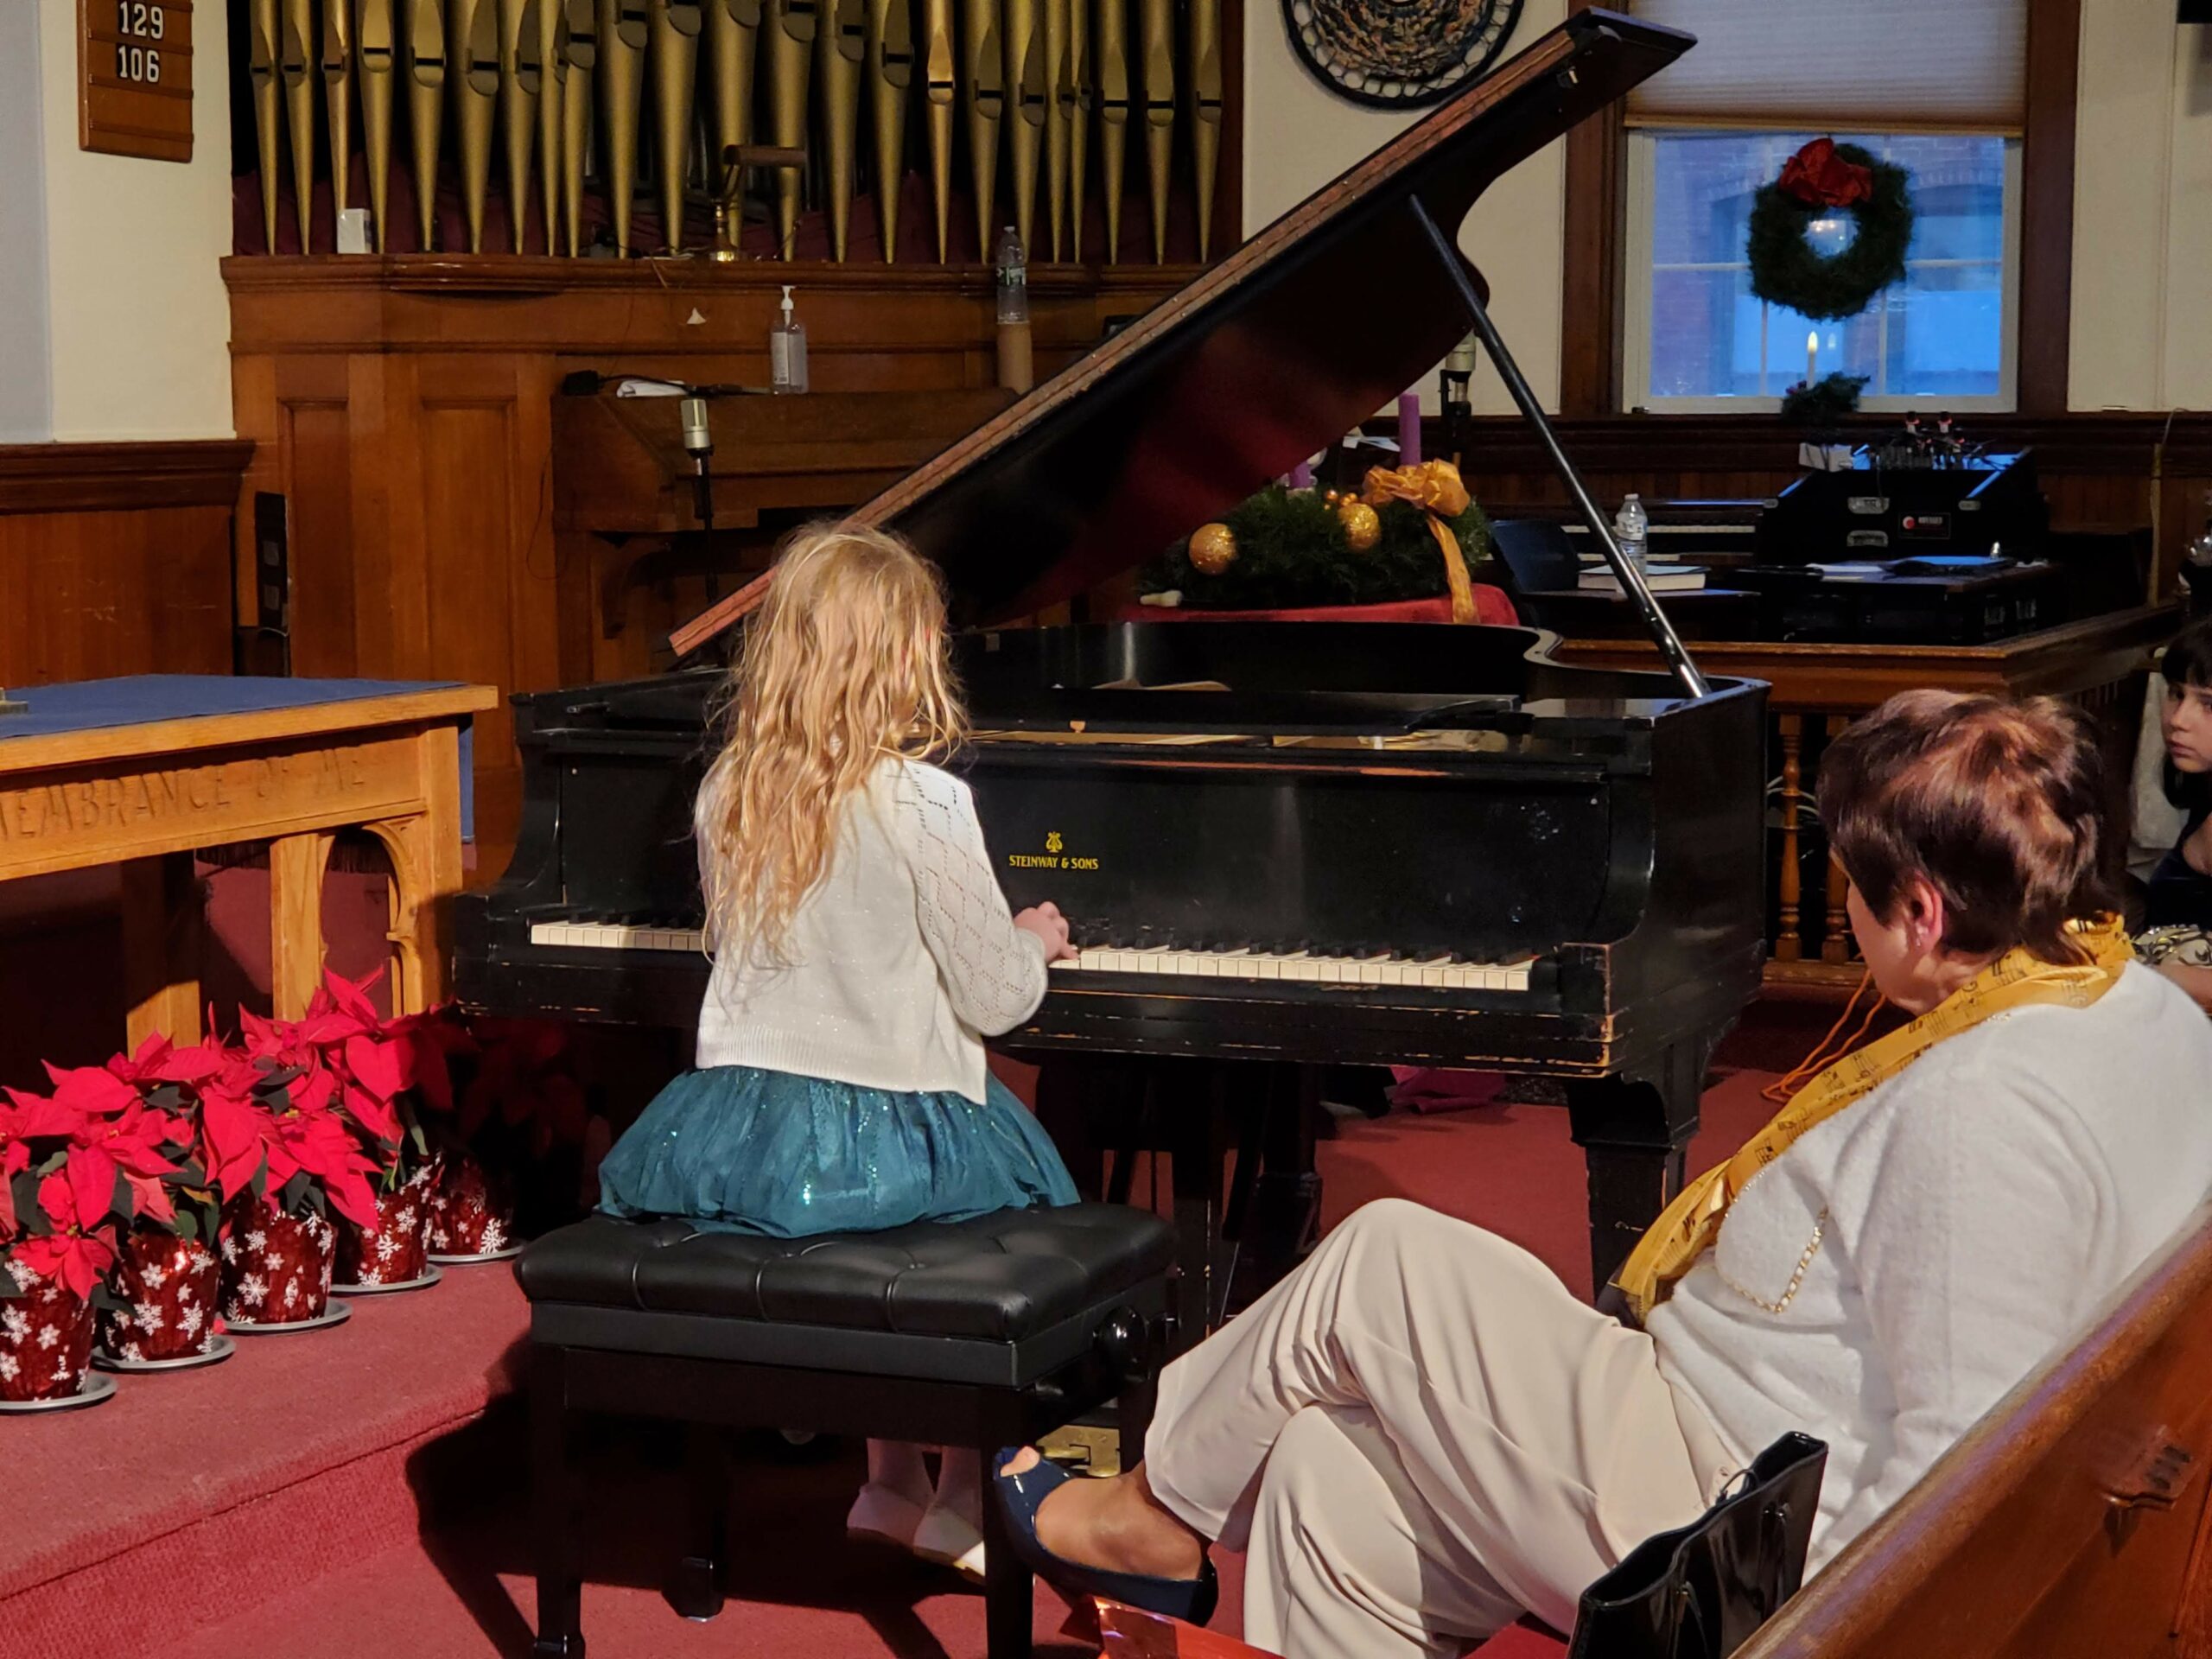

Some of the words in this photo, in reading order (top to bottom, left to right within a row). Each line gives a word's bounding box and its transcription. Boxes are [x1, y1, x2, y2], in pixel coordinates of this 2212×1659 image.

[119, 0, 164, 40] 129
[118, 45, 160, 83] 106
[1008, 855, 1058, 868] STEINWAY
[1061, 857, 1070, 869] &
[1071, 858, 1099, 870] SONS
